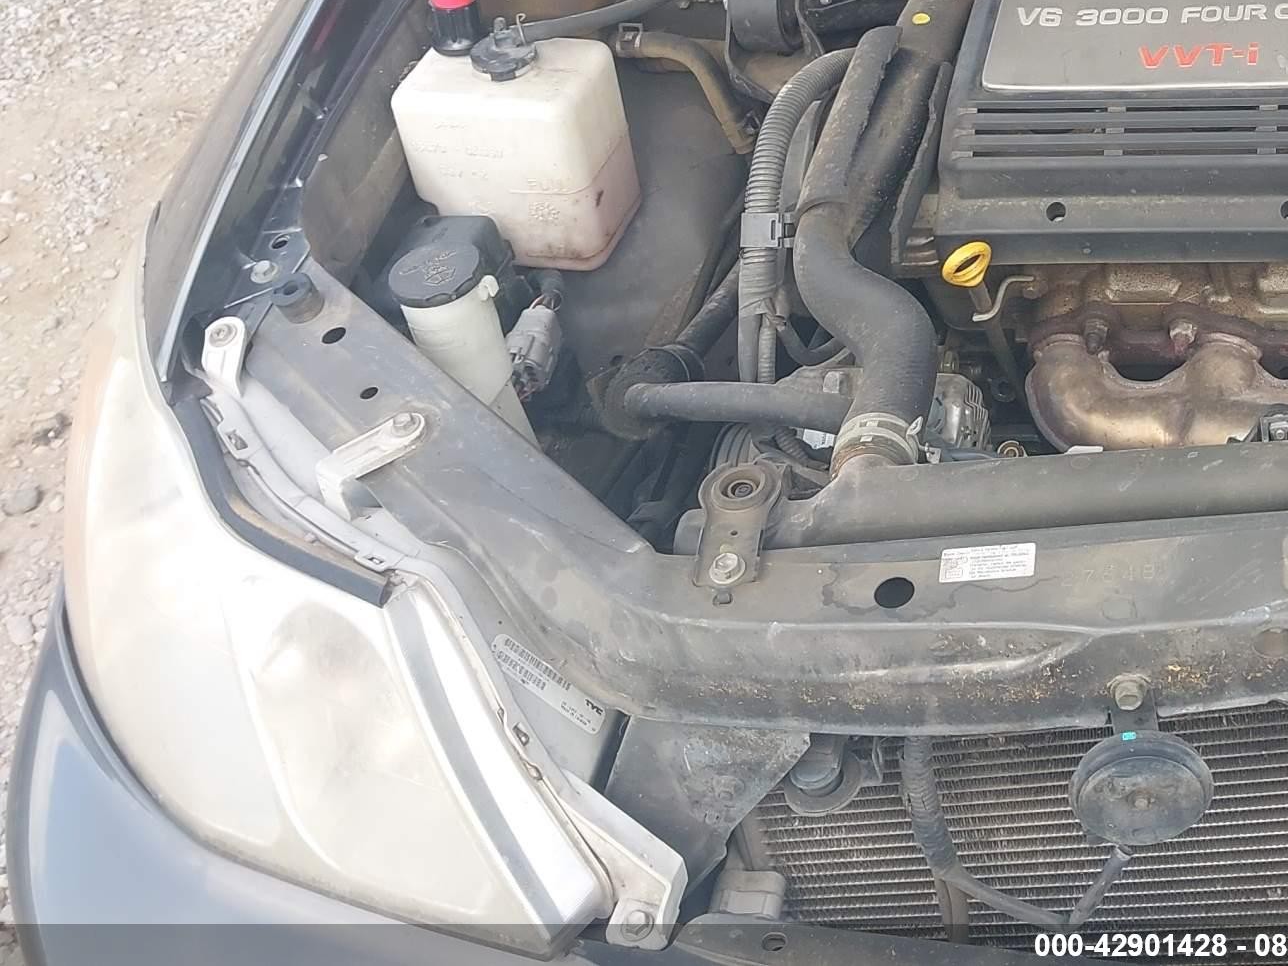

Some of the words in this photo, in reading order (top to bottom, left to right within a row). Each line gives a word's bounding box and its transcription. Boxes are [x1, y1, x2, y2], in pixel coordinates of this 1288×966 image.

[1016, 7, 1063, 27] V6
[1075, 7, 1170, 27] 3000
[1180, 5, 1267, 24] FOUR
[1138, 42, 1260, 69] VVT-i
